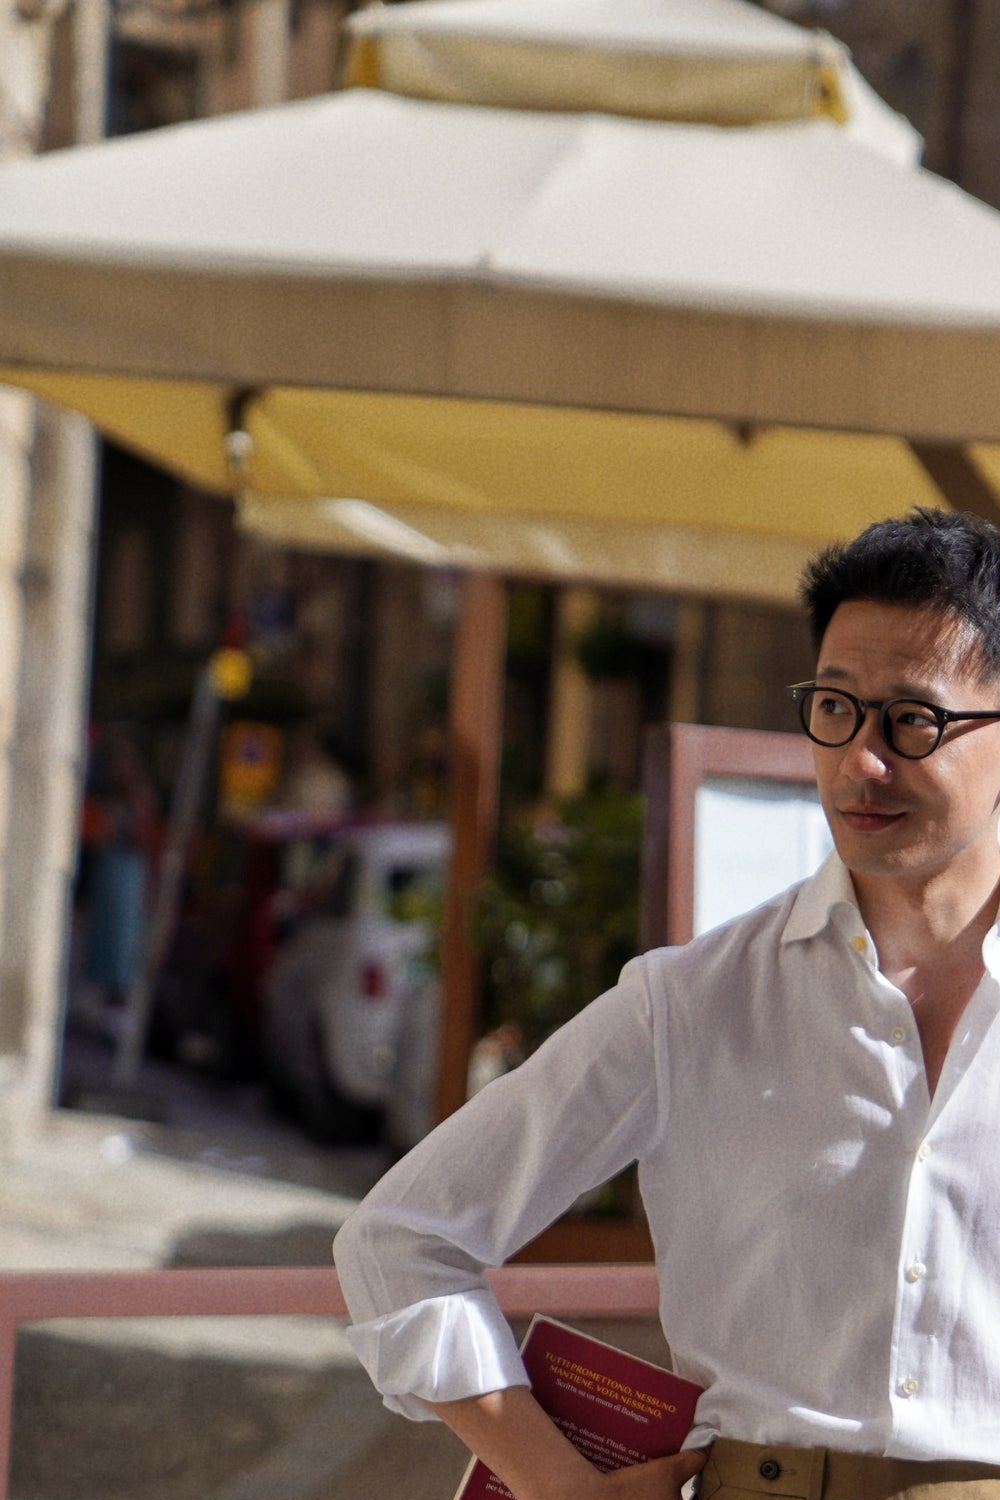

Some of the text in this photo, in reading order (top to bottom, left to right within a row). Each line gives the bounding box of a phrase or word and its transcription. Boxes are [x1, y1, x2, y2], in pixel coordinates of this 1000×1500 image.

[544, 1351, 676, 1413] TUTTI PROMETTONO, NESSUNO
[555, 1378, 578, 1392] Scritta
[595, 1397, 613, 1408] muro
[613, 1403, 621, 1411] di
[595, 1384, 620, 1400] VOTA
[619, 1394, 663, 1418] NESSUNO.
[571, 1434, 610, 1455] progressivo
[578, 1426, 604, 1442] elezioni
